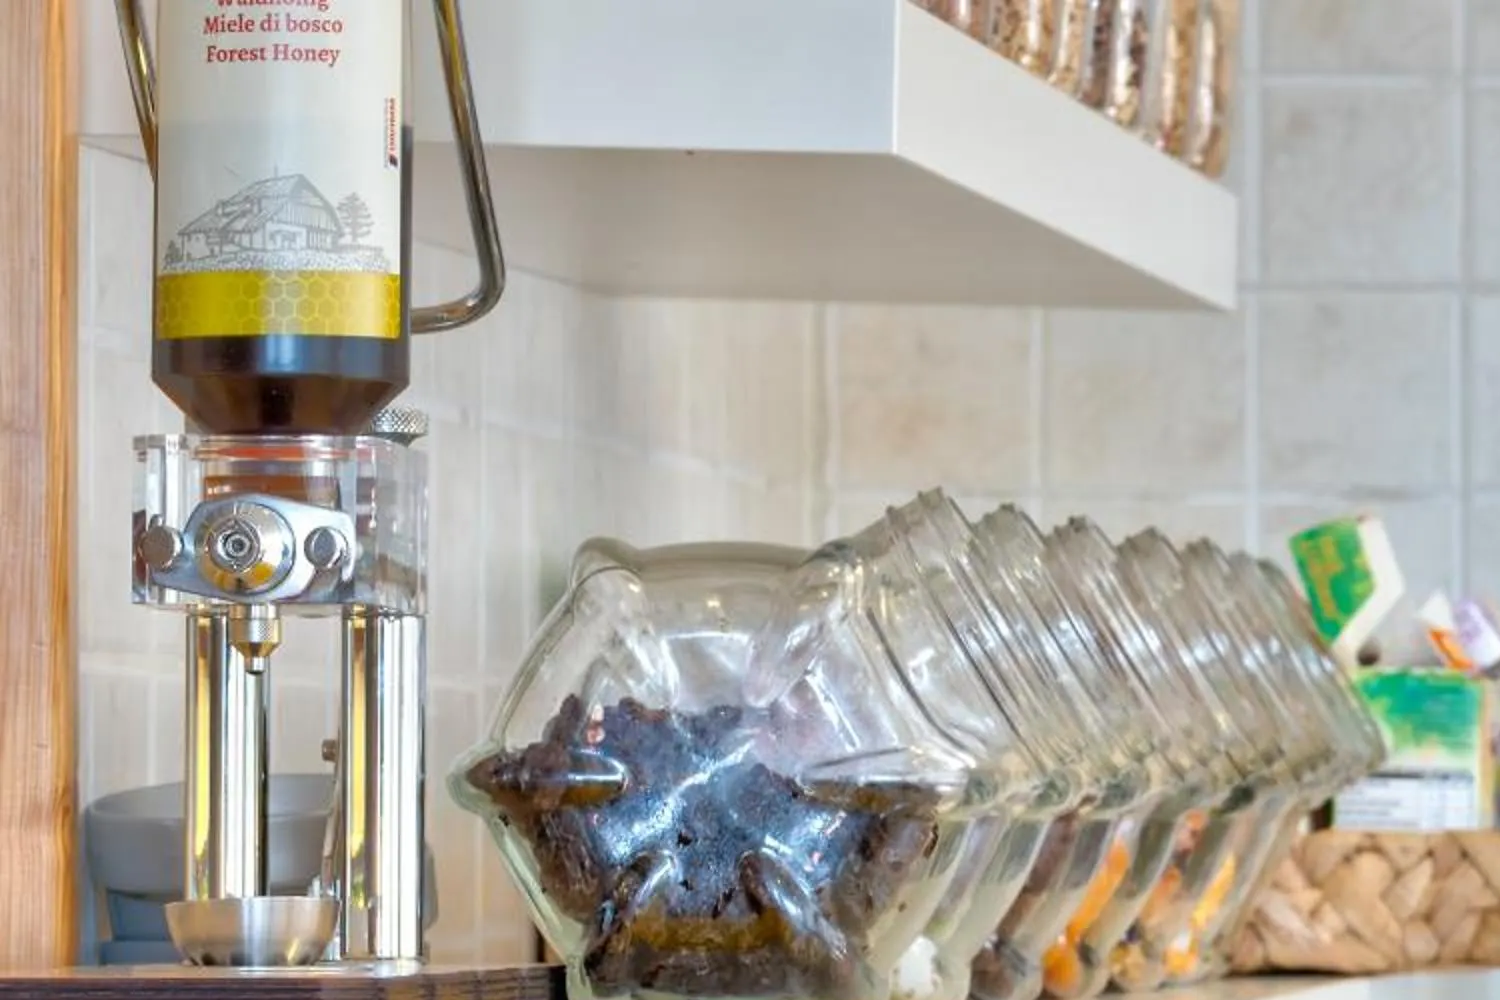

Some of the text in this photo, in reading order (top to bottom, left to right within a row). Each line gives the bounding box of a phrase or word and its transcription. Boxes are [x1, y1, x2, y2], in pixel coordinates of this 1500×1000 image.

[203, 13, 343, 35] Miele di bosco
[206, 43, 341, 67] Forest Honey
